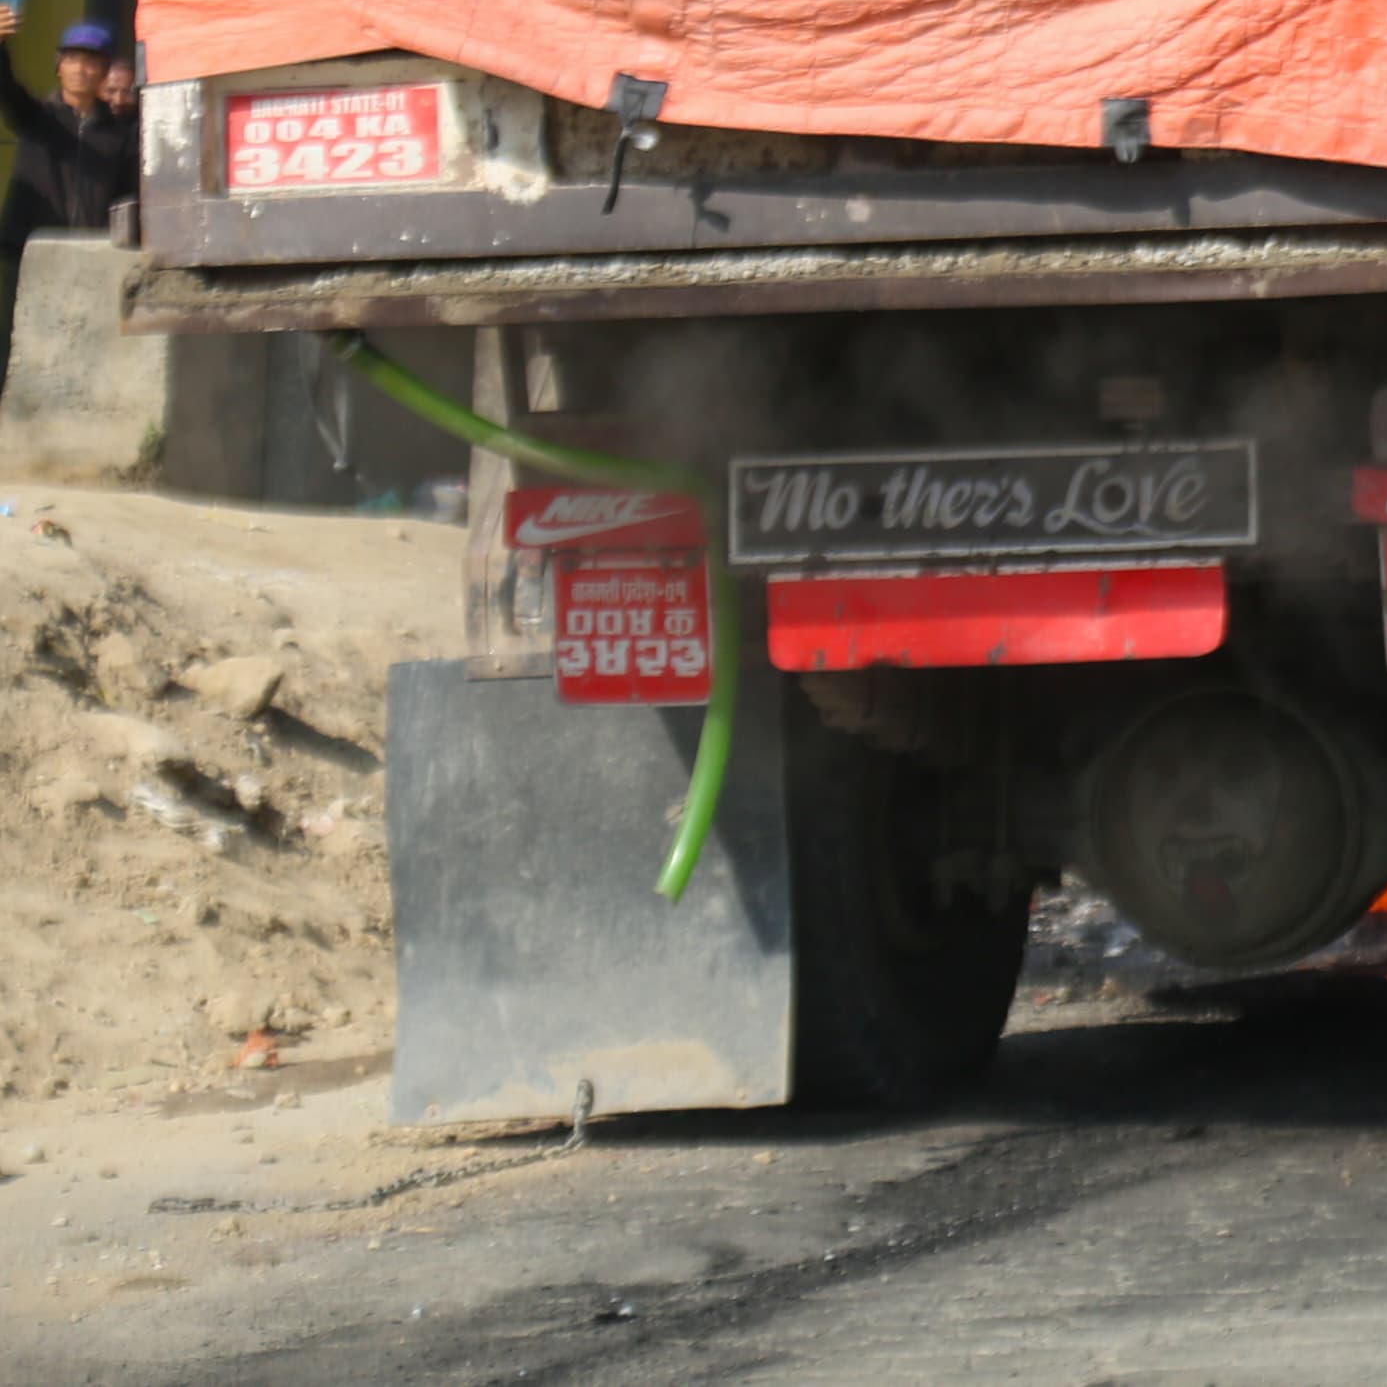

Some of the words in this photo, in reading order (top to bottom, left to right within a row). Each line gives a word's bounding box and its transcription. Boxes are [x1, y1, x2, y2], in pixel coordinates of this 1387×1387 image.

[333, 91, 406, 115] STATE-01
[243, 117, 344, 144] 004
[355, 114, 412, 139] KA
[233, 139, 424, 186] 3423
[538, 492, 657, 524] NIKE
[1043, 455, 1211, 539] Love
[663, 608, 697, 637] क
[558, 637, 706, 678] ३४२३
